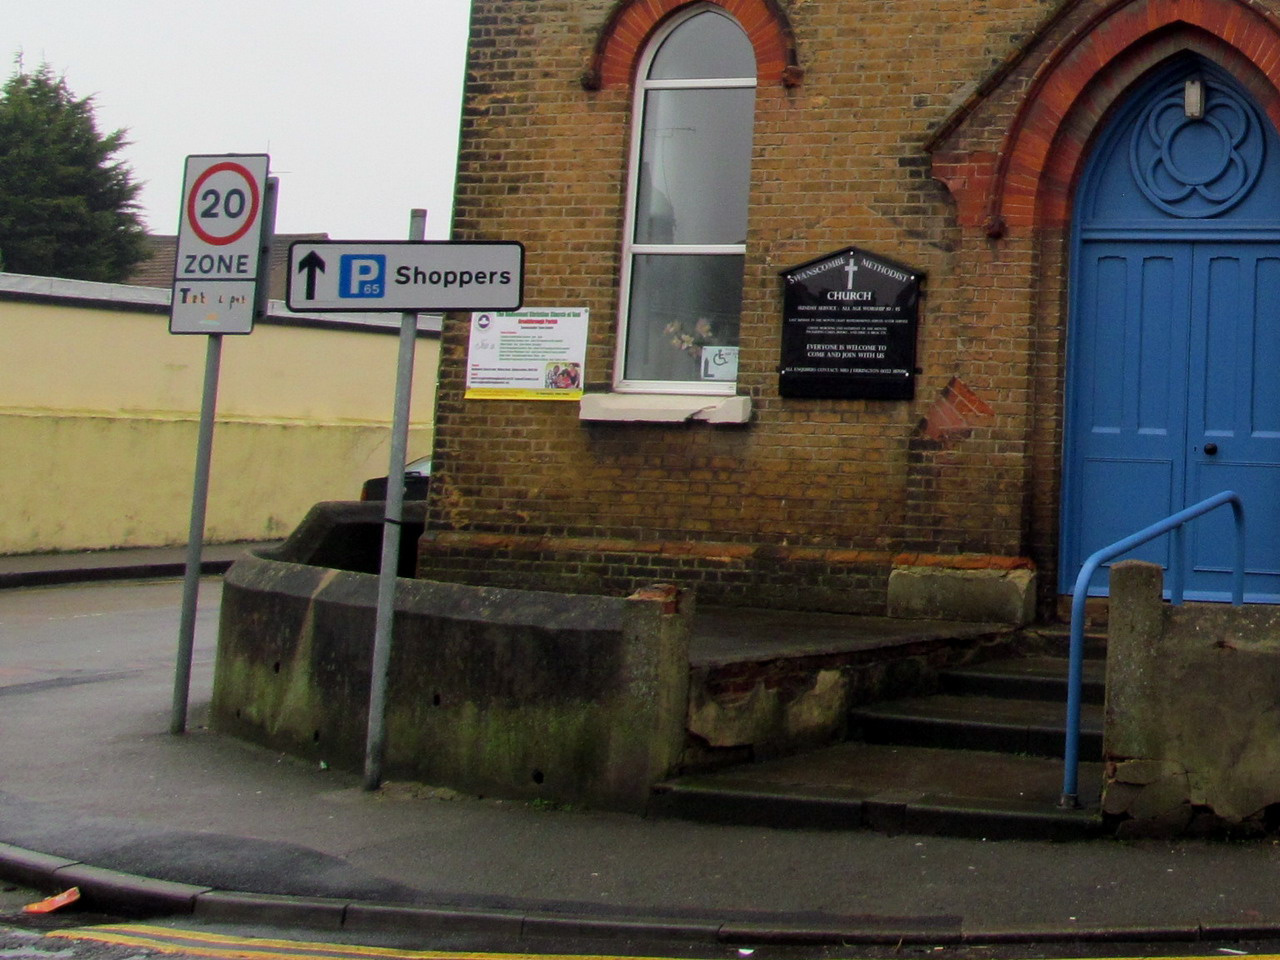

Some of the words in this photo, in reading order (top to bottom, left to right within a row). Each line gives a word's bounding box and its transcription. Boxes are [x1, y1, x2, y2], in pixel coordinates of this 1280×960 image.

[200, 188, 246, 219] 20
[184, 254, 249, 274] ZONE
[789, 257, 846, 285] SWANSCOMBE
[861, 258, 909, 283] METHODIST
[350, 259, 380, 295] P
[395, 266, 511, 288] Shoppers
[363, 284, 380, 295] 65
[827, 291, 872, 301] CHURCH
[841, 351, 856, 359] JOIN
